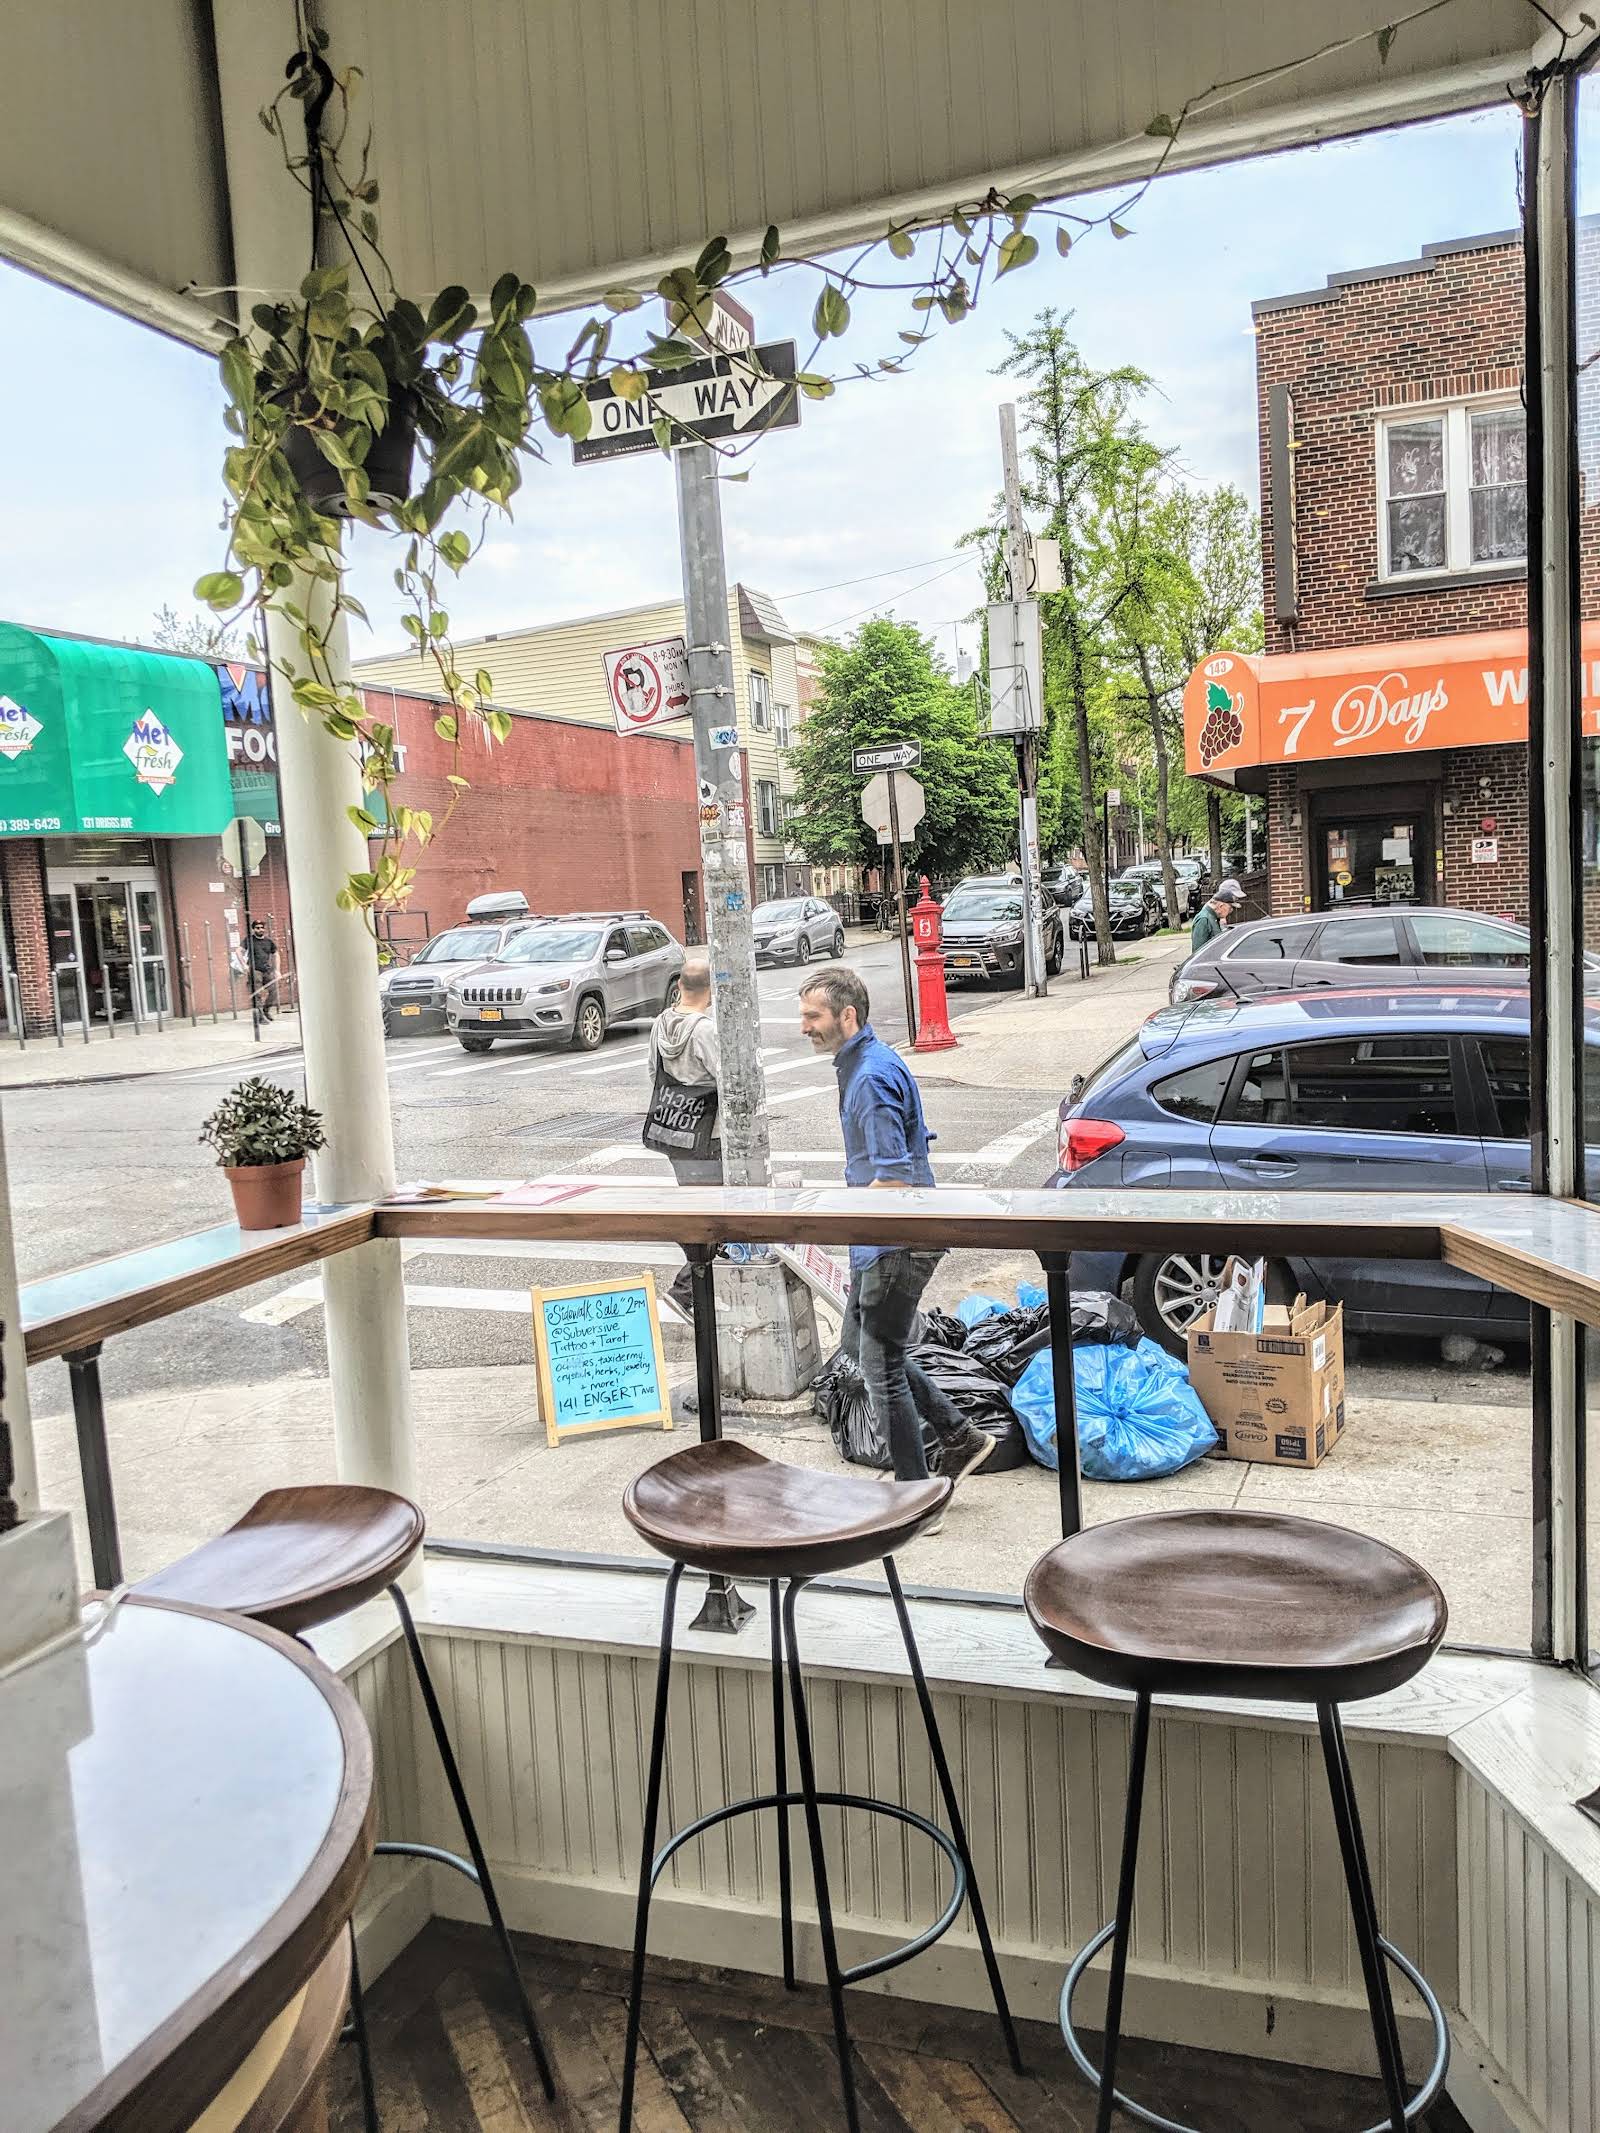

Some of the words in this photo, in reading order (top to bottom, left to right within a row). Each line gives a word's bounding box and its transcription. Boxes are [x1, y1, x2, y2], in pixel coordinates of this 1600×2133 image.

[717, 309, 744, 350] WAY
[603, 392, 662, 432] ONE
[694, 377, 758, 416] WAY
[1209, 661, 1227, 675] 143
[665, 682, 685, 693] THURS
[1278, 699, 1315, 755] 7
[1332, 672, 1448, 744] Days
[133, 721, 170, 745] Met
[136, 745, 173, 772] fresh
[859, 755, 880, 765] ONE
[893, 749, 913, 761] WAY
[10, 818, 60, 831] 389-6429
[626, 1296, 645, 1314] 2PM
[552, 1322, 620, 1340] @Subversive
[551, 1340, 588, 1355] Tattoo
[596, 1330, 629, 1347] Tarot
[622, 1359, 650, 1376] jewelry
[590, 1378, 619, 1391] more!
[559, 1396, 577, 1413] 141
[584, 1385, 643, 1407] ENGERT
[641, 1386, 655, 1395] AVE
